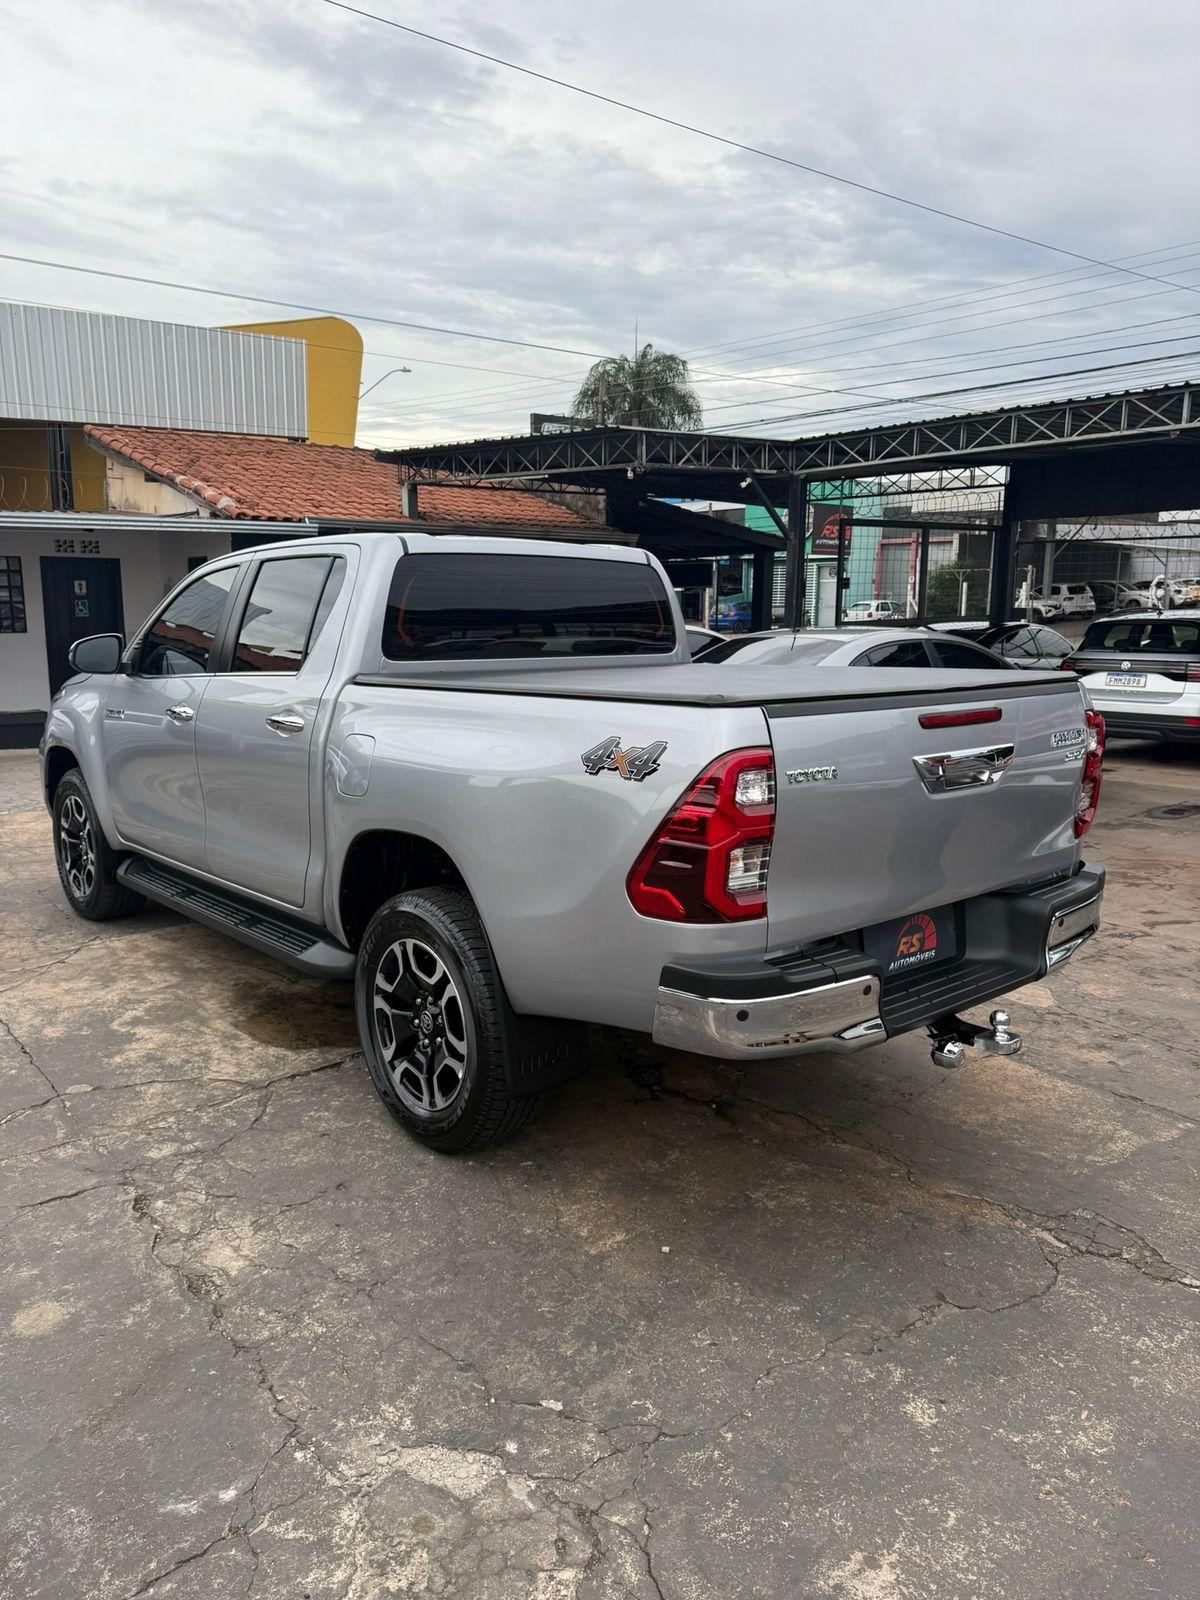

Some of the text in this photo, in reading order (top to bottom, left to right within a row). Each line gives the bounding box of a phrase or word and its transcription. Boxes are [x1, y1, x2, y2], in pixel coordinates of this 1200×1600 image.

[785, 766, 838, 783] TOYOTA
[896, 933, 925, 957] RS
[888, 949, 936, 971] AUTOMÓVEIS
